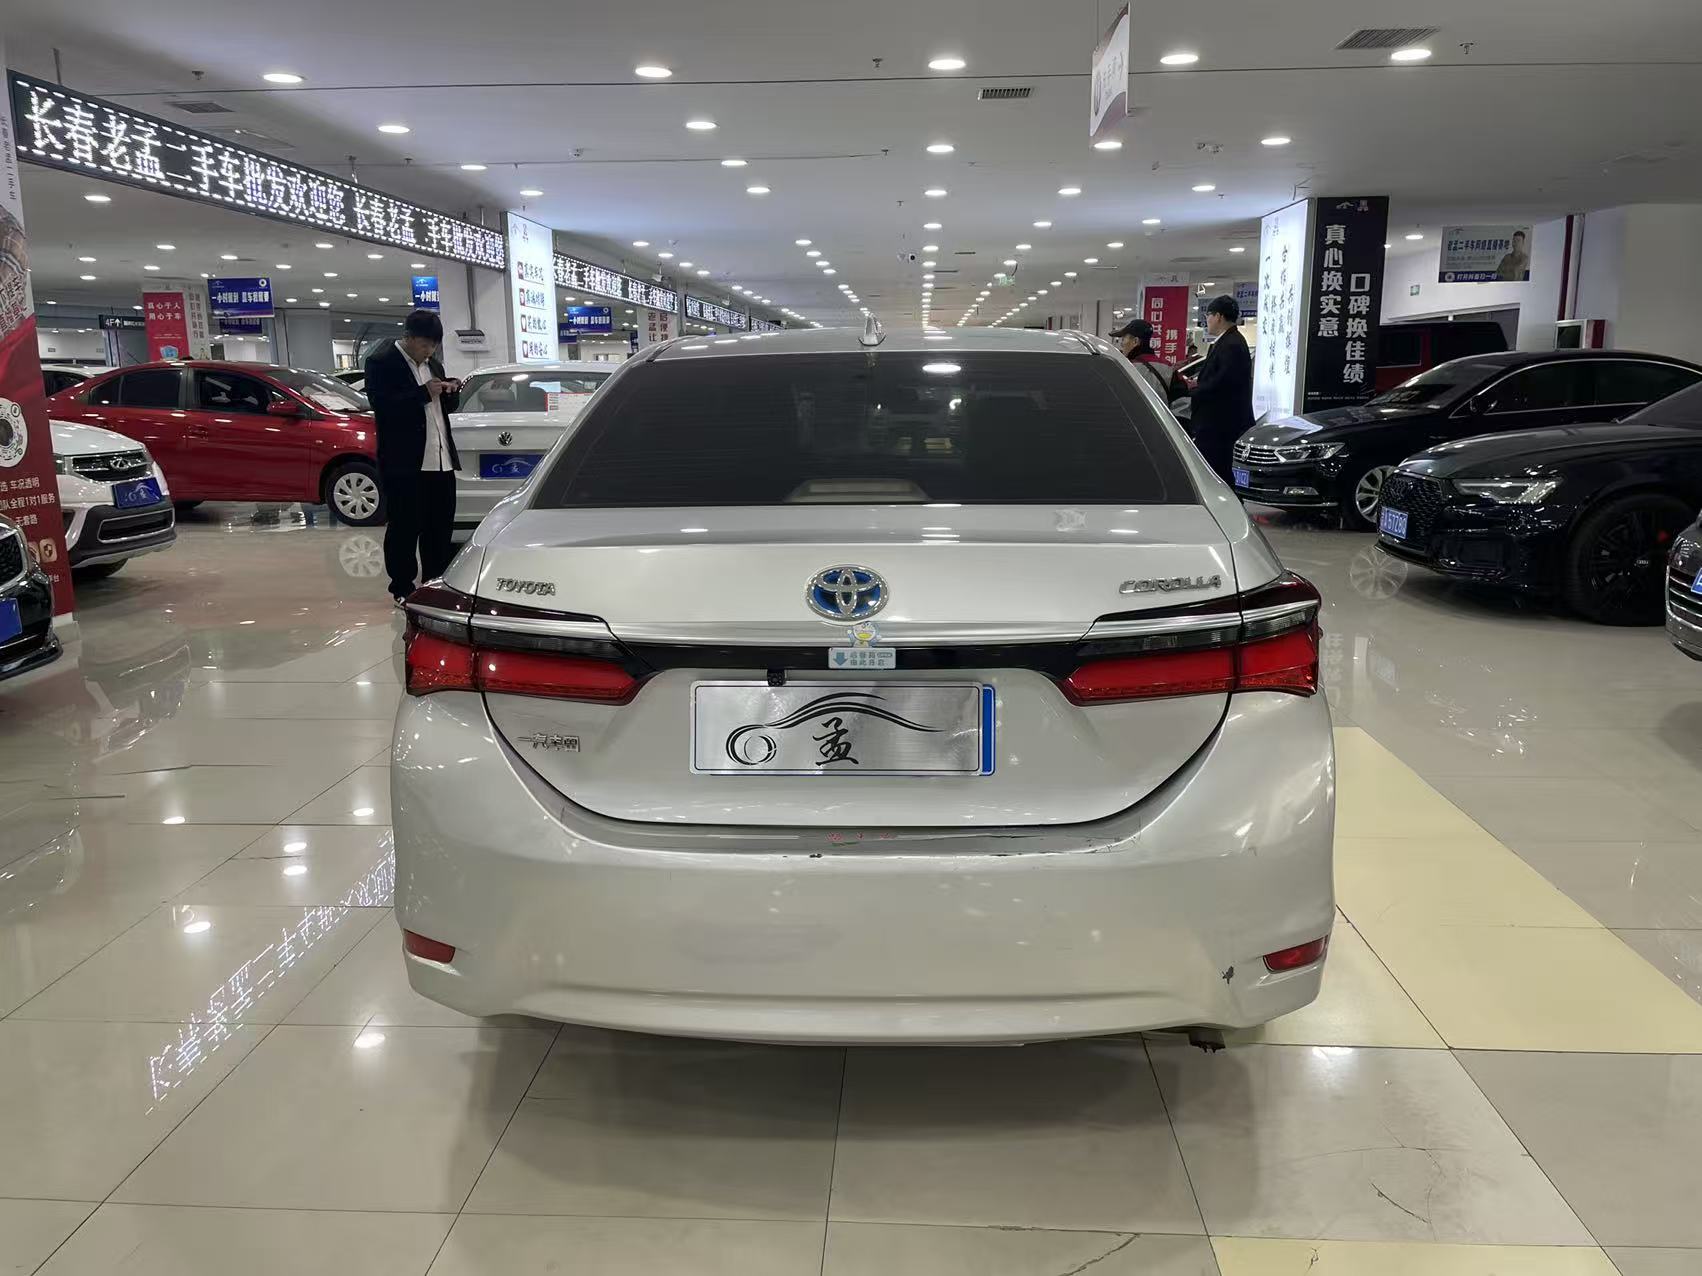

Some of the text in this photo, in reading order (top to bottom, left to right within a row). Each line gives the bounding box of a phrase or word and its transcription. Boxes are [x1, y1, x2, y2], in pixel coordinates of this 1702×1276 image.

[1318, 224, 1346, 337] 真心换实意
[1343, 273, 1371, 384] 口碑换佳绩
[10, 477, 40, 490] 车况透明
[0, 493, 55, 511] 队全程1对1服务
[496, 577, 556, 596] TOYOTA
[1119, 575, 1221, 594] COROLLA
[813, 717, 859, 766] 孟
